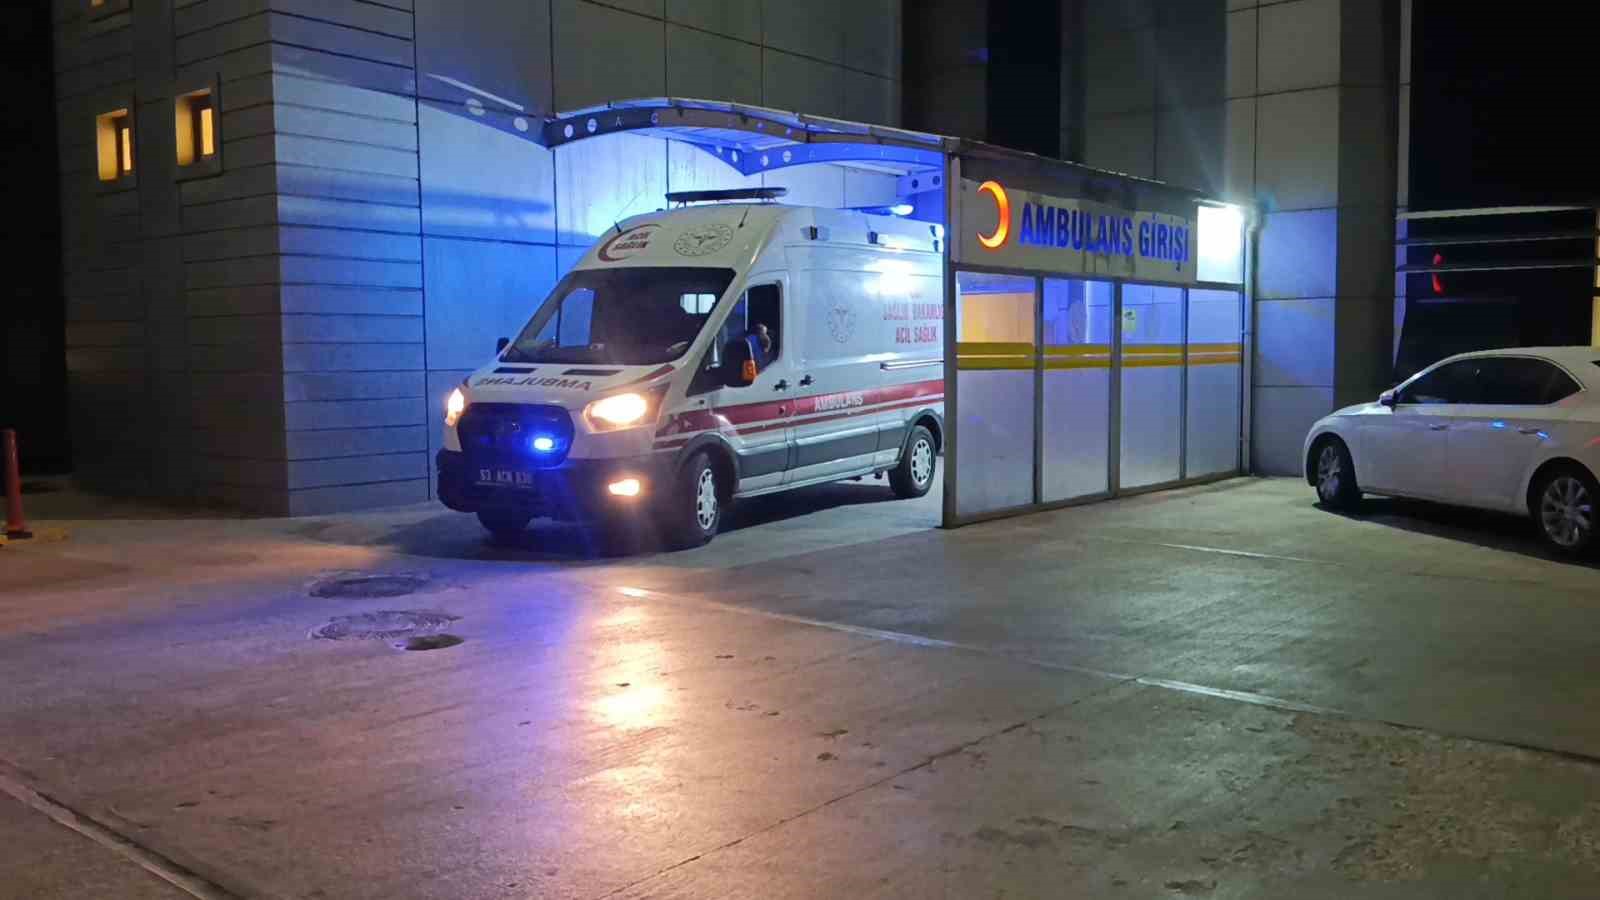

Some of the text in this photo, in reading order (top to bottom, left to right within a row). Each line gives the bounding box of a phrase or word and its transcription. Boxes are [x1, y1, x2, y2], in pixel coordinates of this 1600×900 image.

[1019, 203, 1189, 271] AMBULANS GİRİŞİ
[815, 393, 863, 412] AMBULANS
